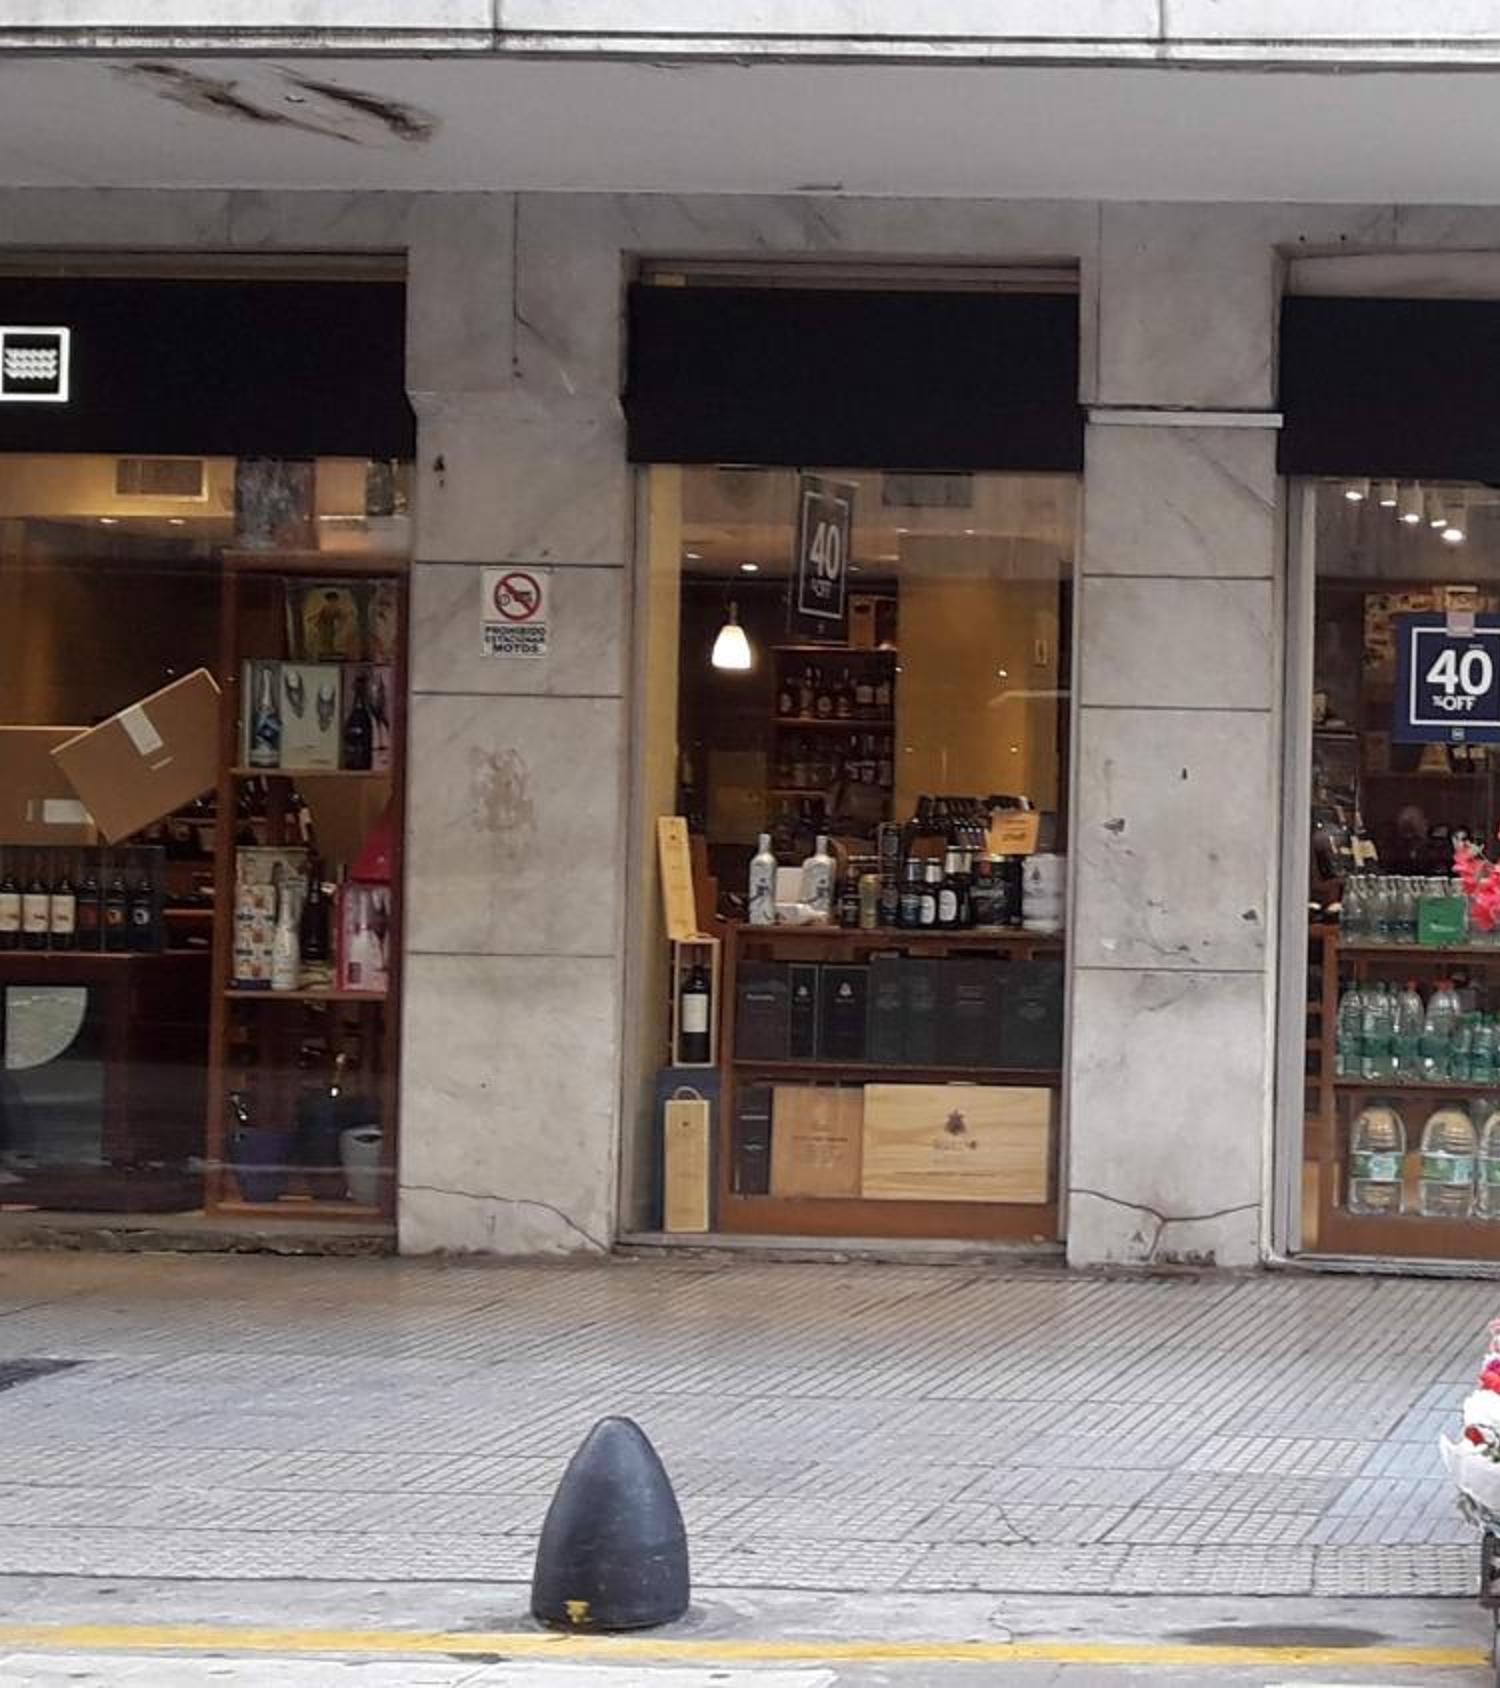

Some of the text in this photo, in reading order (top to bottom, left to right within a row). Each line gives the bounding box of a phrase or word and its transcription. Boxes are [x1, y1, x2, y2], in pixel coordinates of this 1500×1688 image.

[809, 521, 841, 581] 40
[485, 626, 546, 636] PROHIBIDO
[492, 643, 540, 653] MOTOS
[1425, 648, 1494, 696] 40
